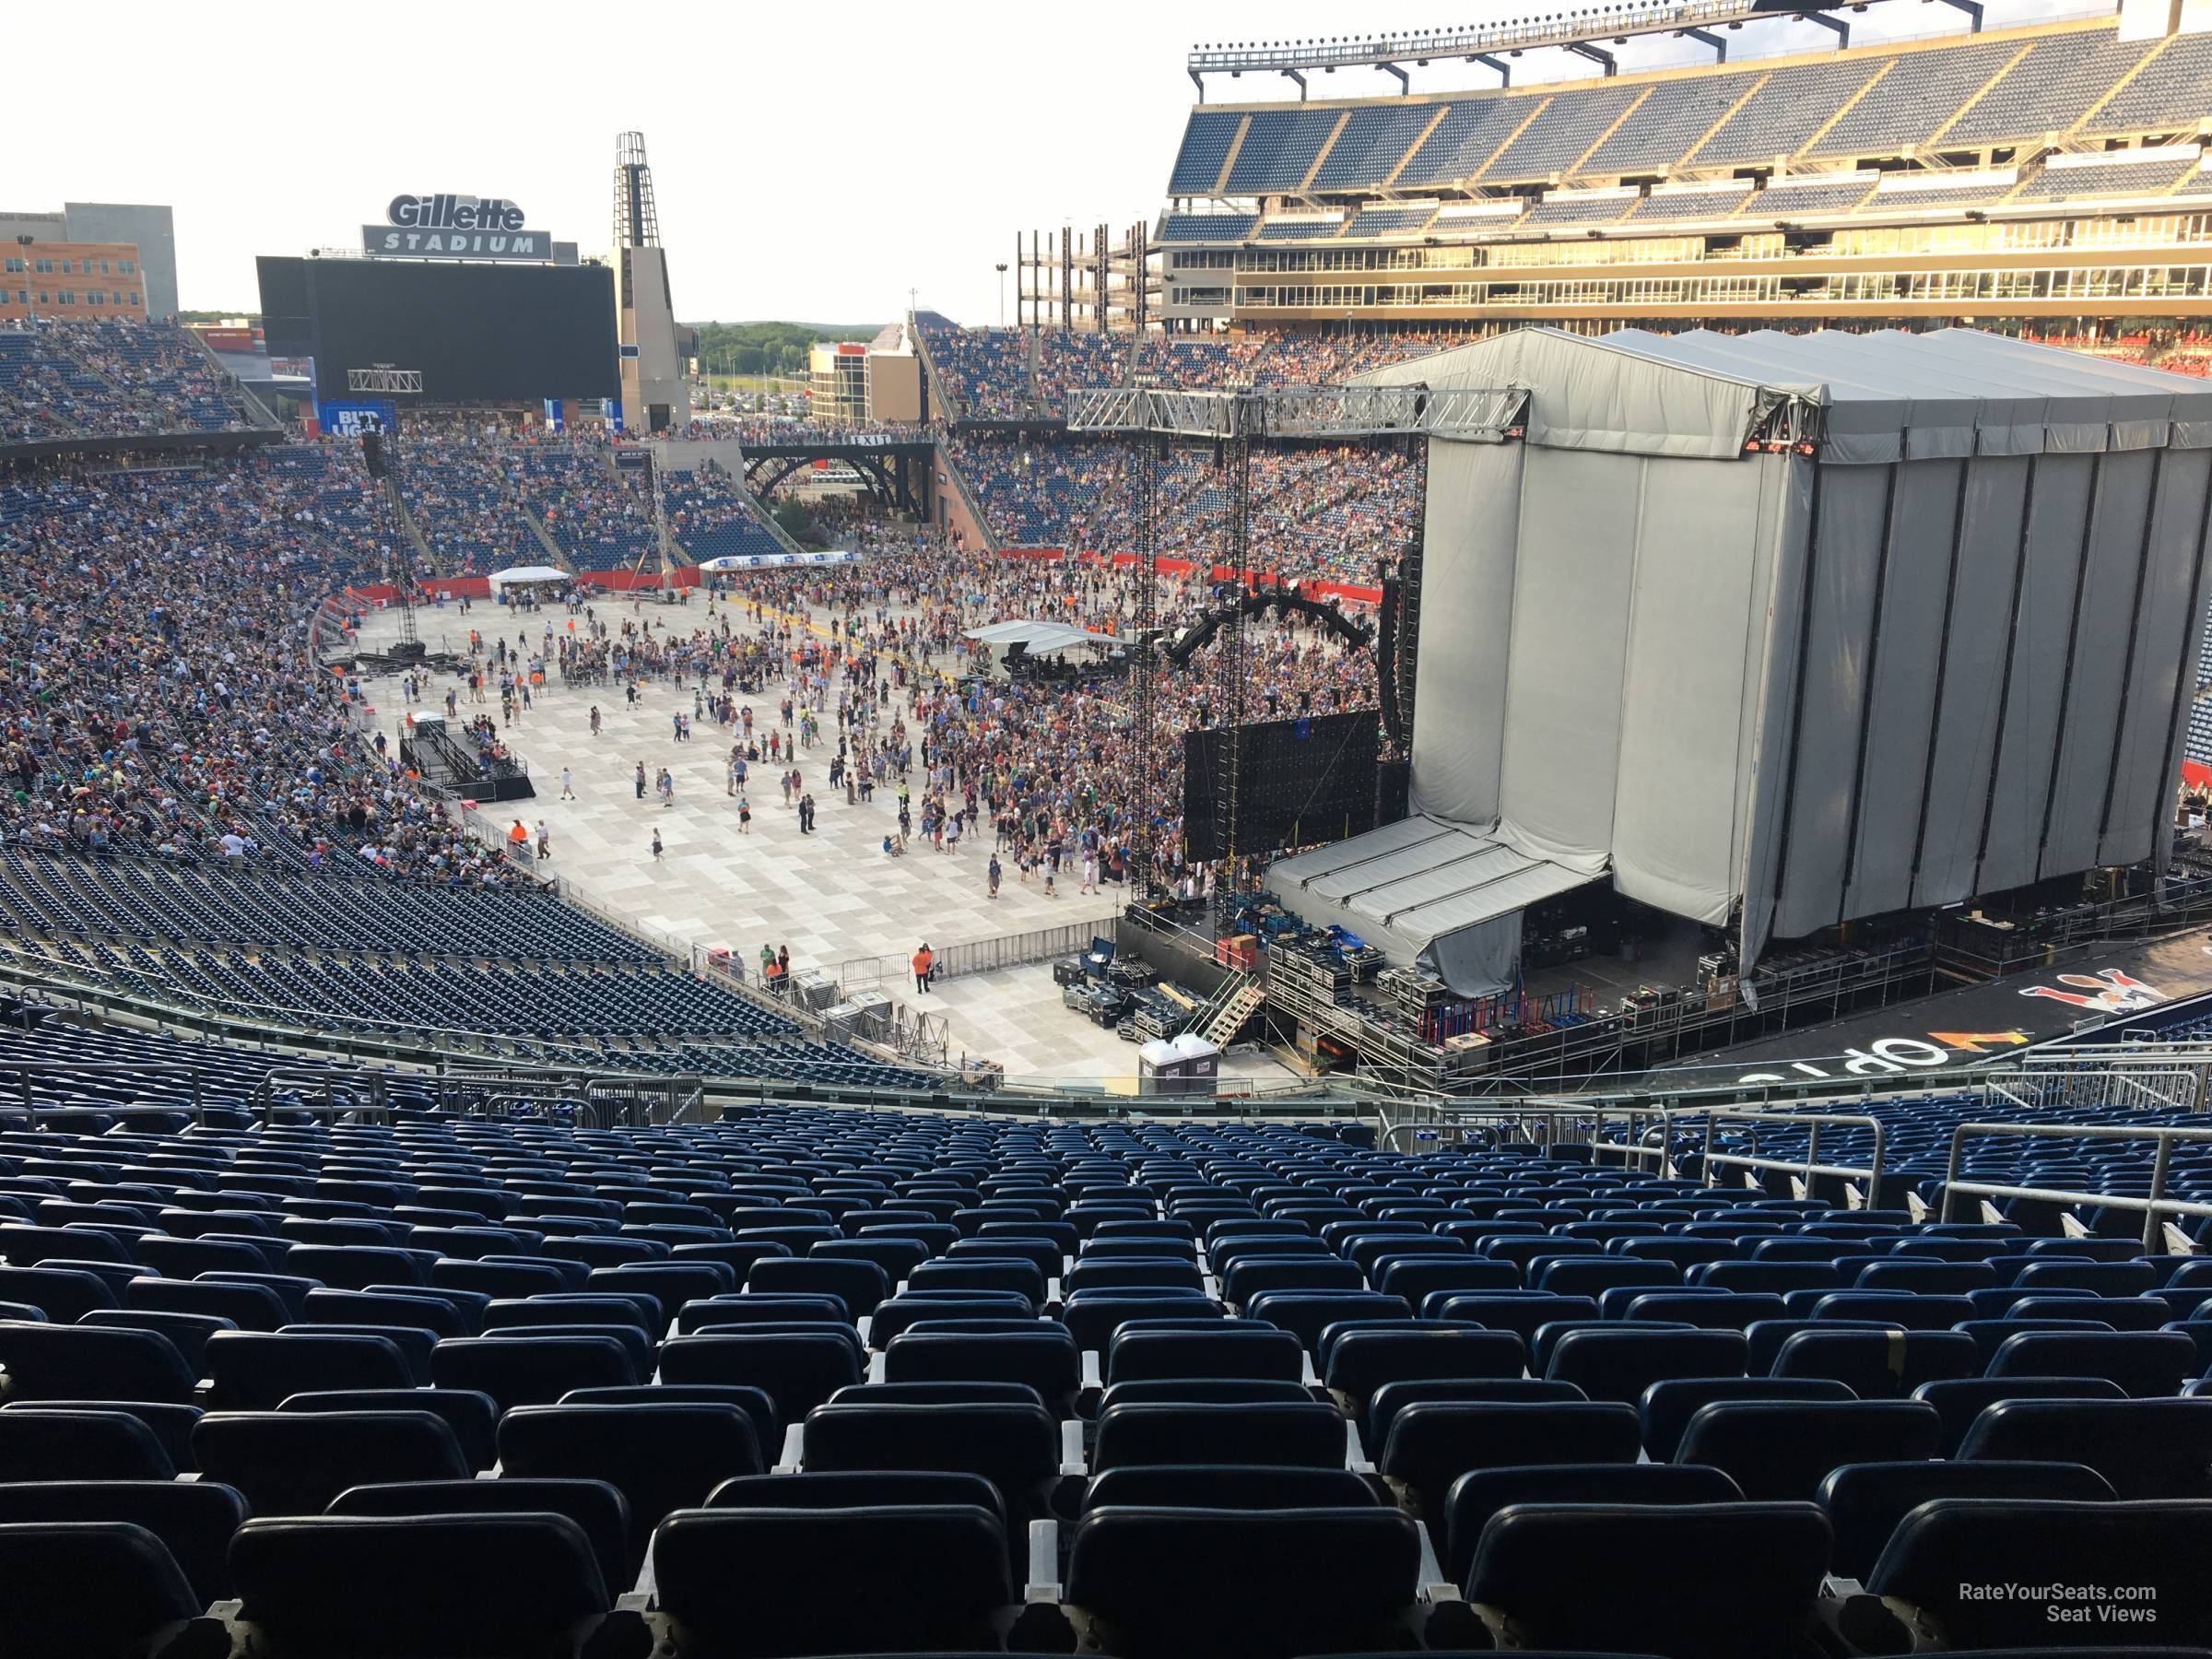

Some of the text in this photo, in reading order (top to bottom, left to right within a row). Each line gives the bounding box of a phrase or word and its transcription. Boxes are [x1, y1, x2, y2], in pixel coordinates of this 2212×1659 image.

[387, 194, 524, 231] Gillette
[384, 232, 534, 253] STADIUM
[338, 410, 380, 424] BUD
[853, 436, 888, 446] EXIT
